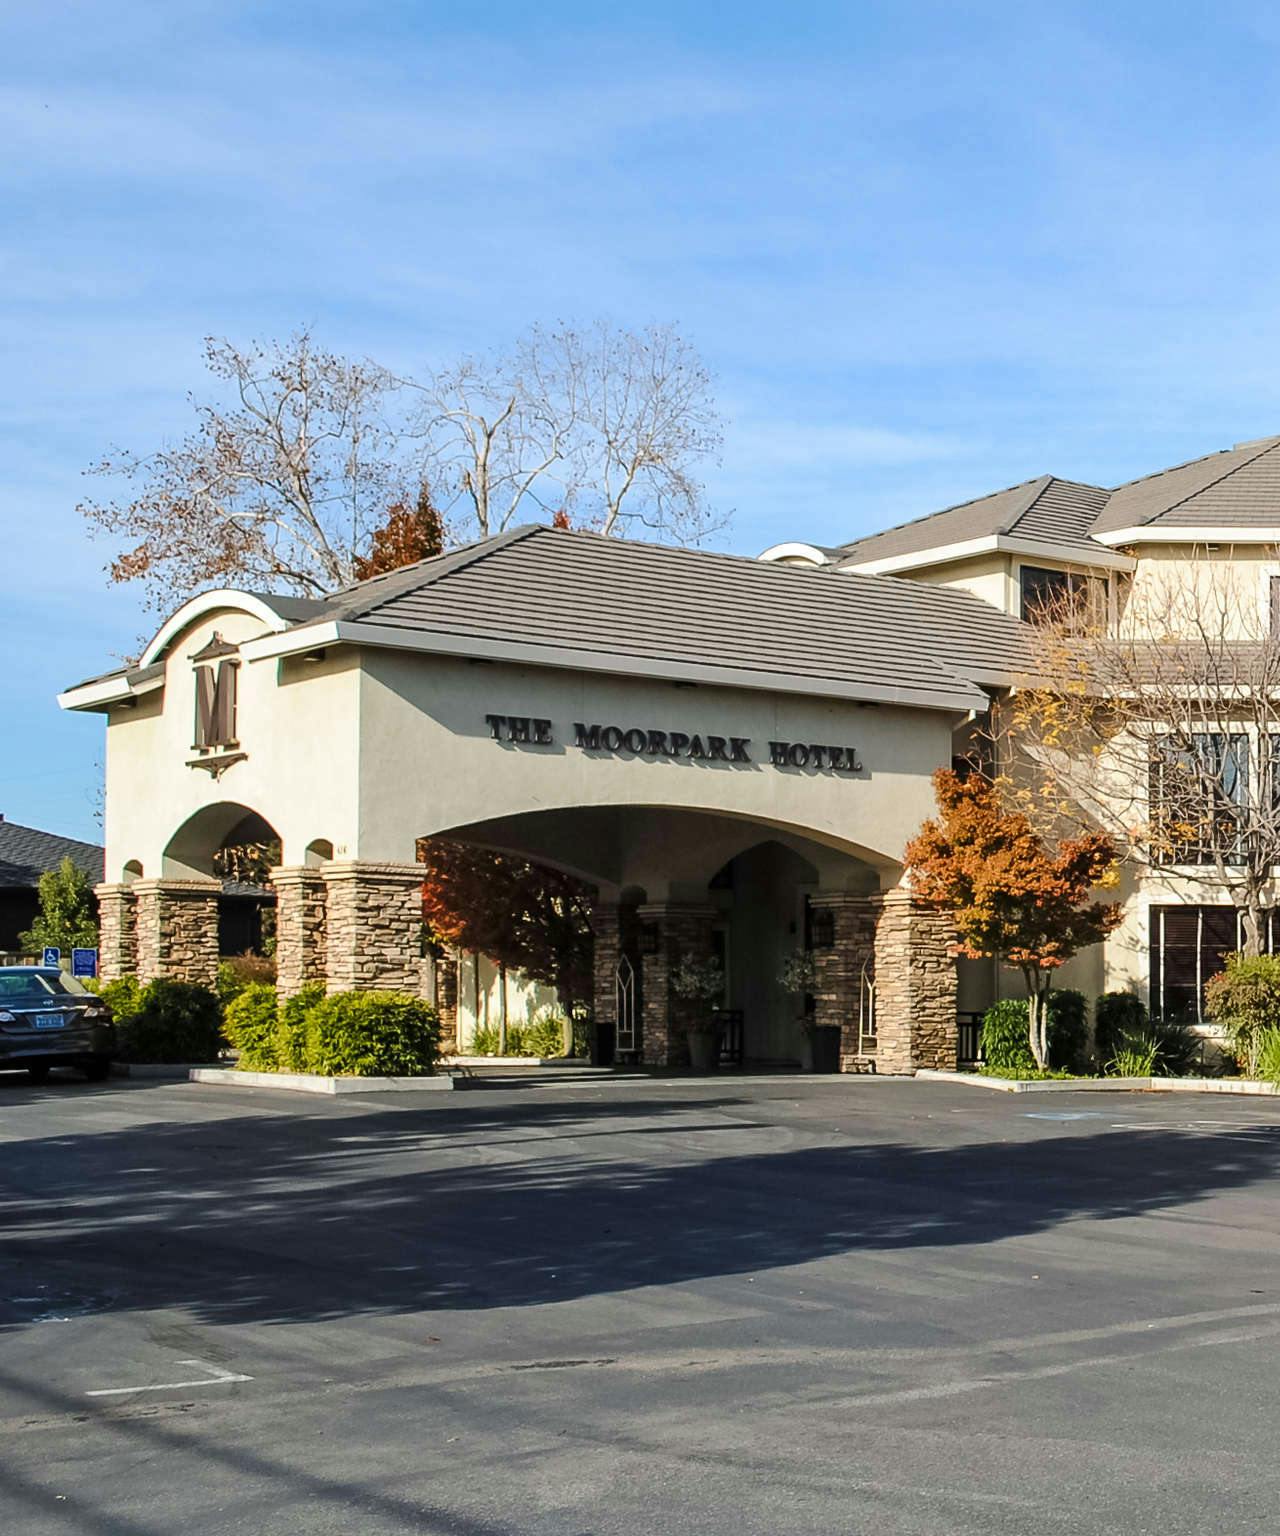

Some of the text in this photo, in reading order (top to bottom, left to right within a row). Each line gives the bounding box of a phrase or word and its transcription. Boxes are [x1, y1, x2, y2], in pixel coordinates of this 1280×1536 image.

[485, 714, 864, 772] THE MOORPARK HOTEL
